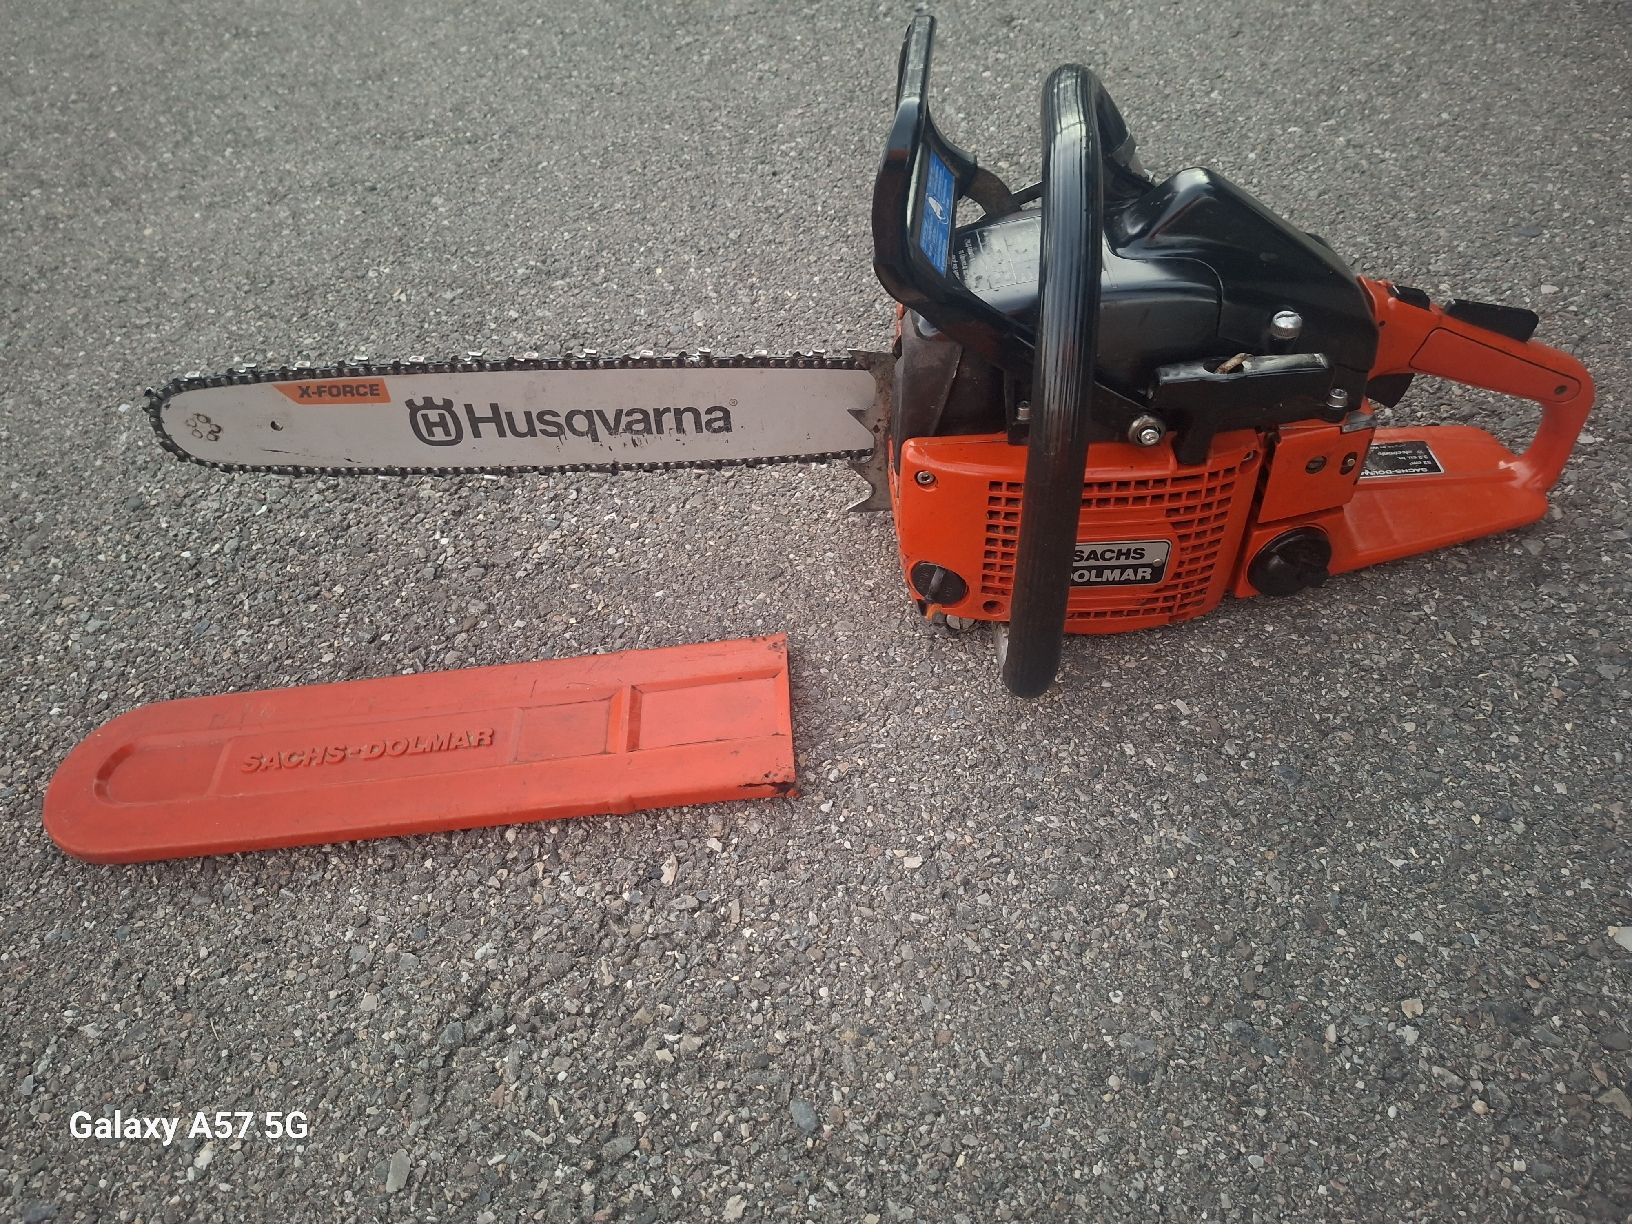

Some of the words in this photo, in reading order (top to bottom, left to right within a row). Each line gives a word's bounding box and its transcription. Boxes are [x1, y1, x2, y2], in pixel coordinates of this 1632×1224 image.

[298, 383, 380, 398] X-FORCE
[463, 402, 733, 442] Husqvarna
[1073, 547, 1146, 563] SACHS
[1071, 567, 1152, 583] OLMAR
[240, 727, 495, 774] SACHS-DOLMAR
